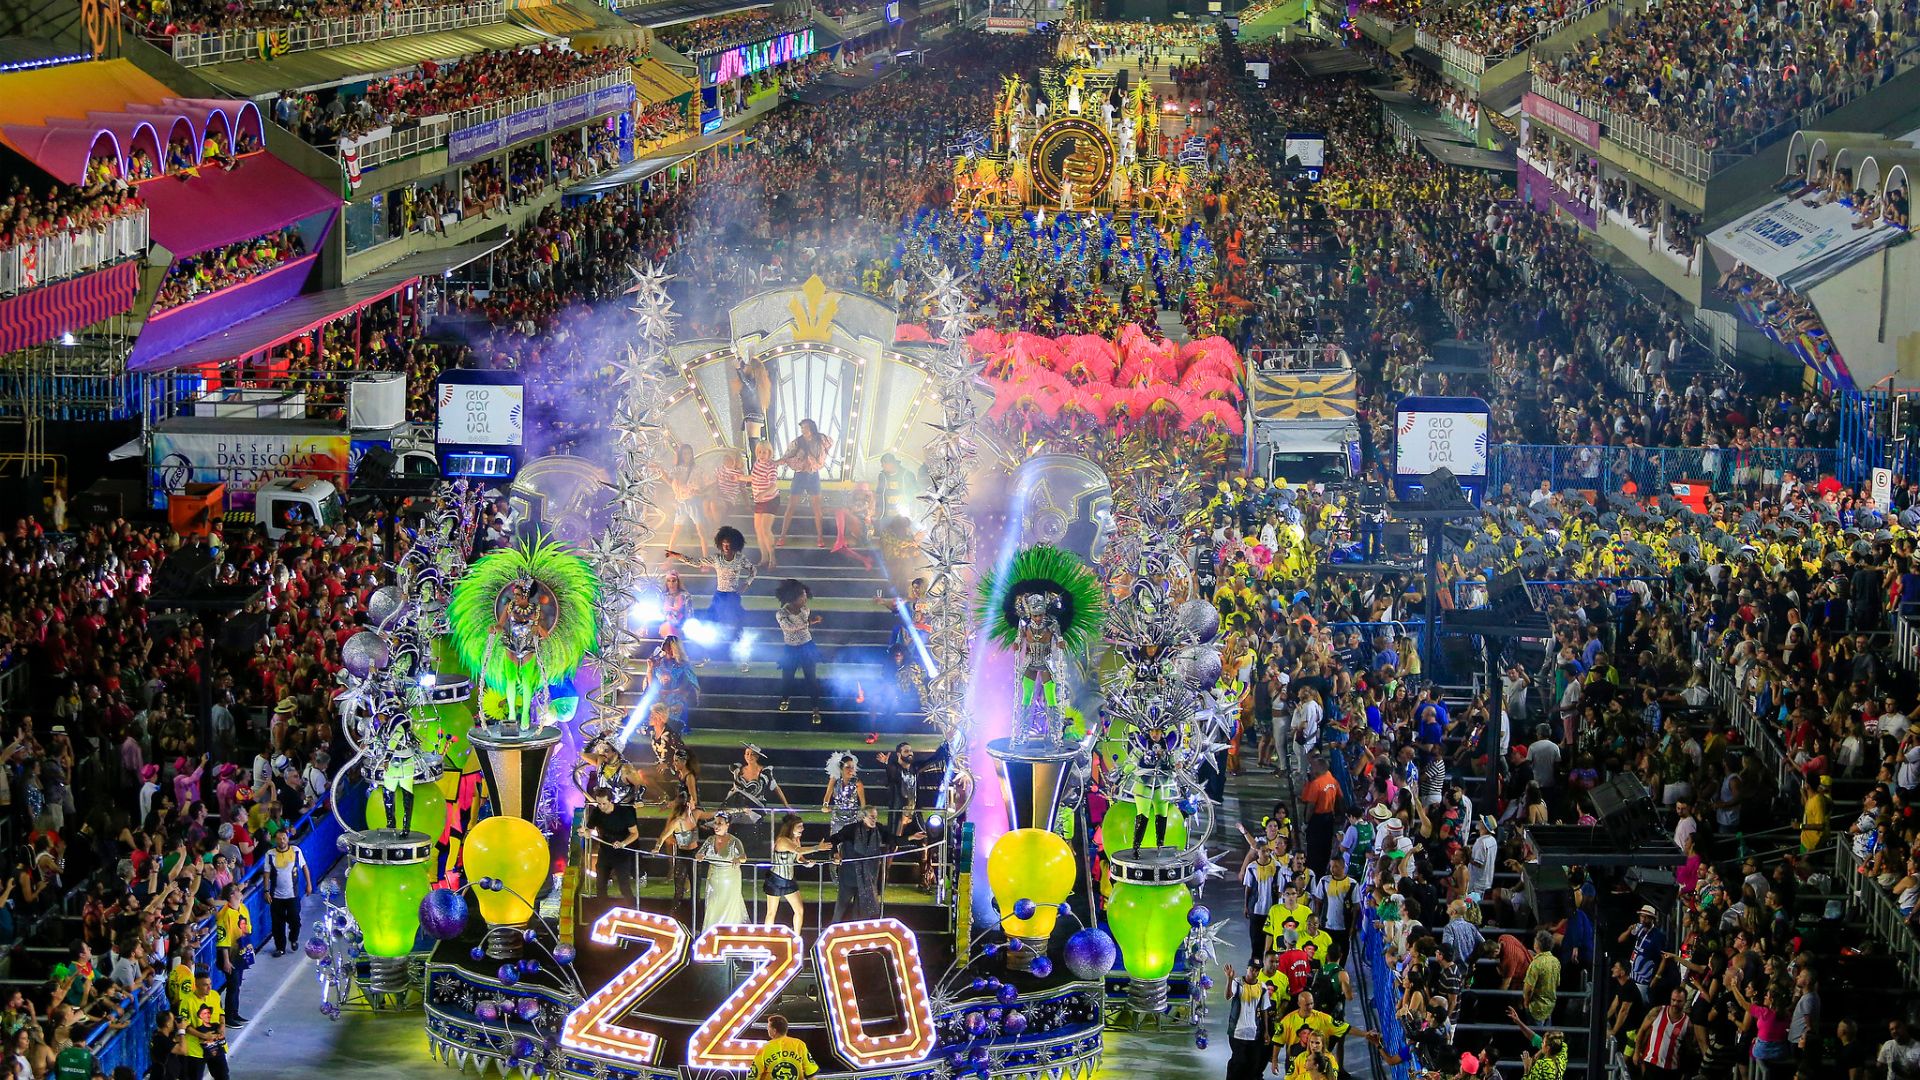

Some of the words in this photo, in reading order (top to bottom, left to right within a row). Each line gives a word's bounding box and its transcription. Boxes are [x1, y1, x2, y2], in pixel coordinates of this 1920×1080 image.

[466, 390, 490, 400] RIO
[1428, 417, 1453, 428] RIO
[217, 443, 317, 453] DESFILE
[217, 454, 246, 466] DAS
[252, 454, 317, 467] ESCOLAS
[561, 906, 938, 1071] 220
